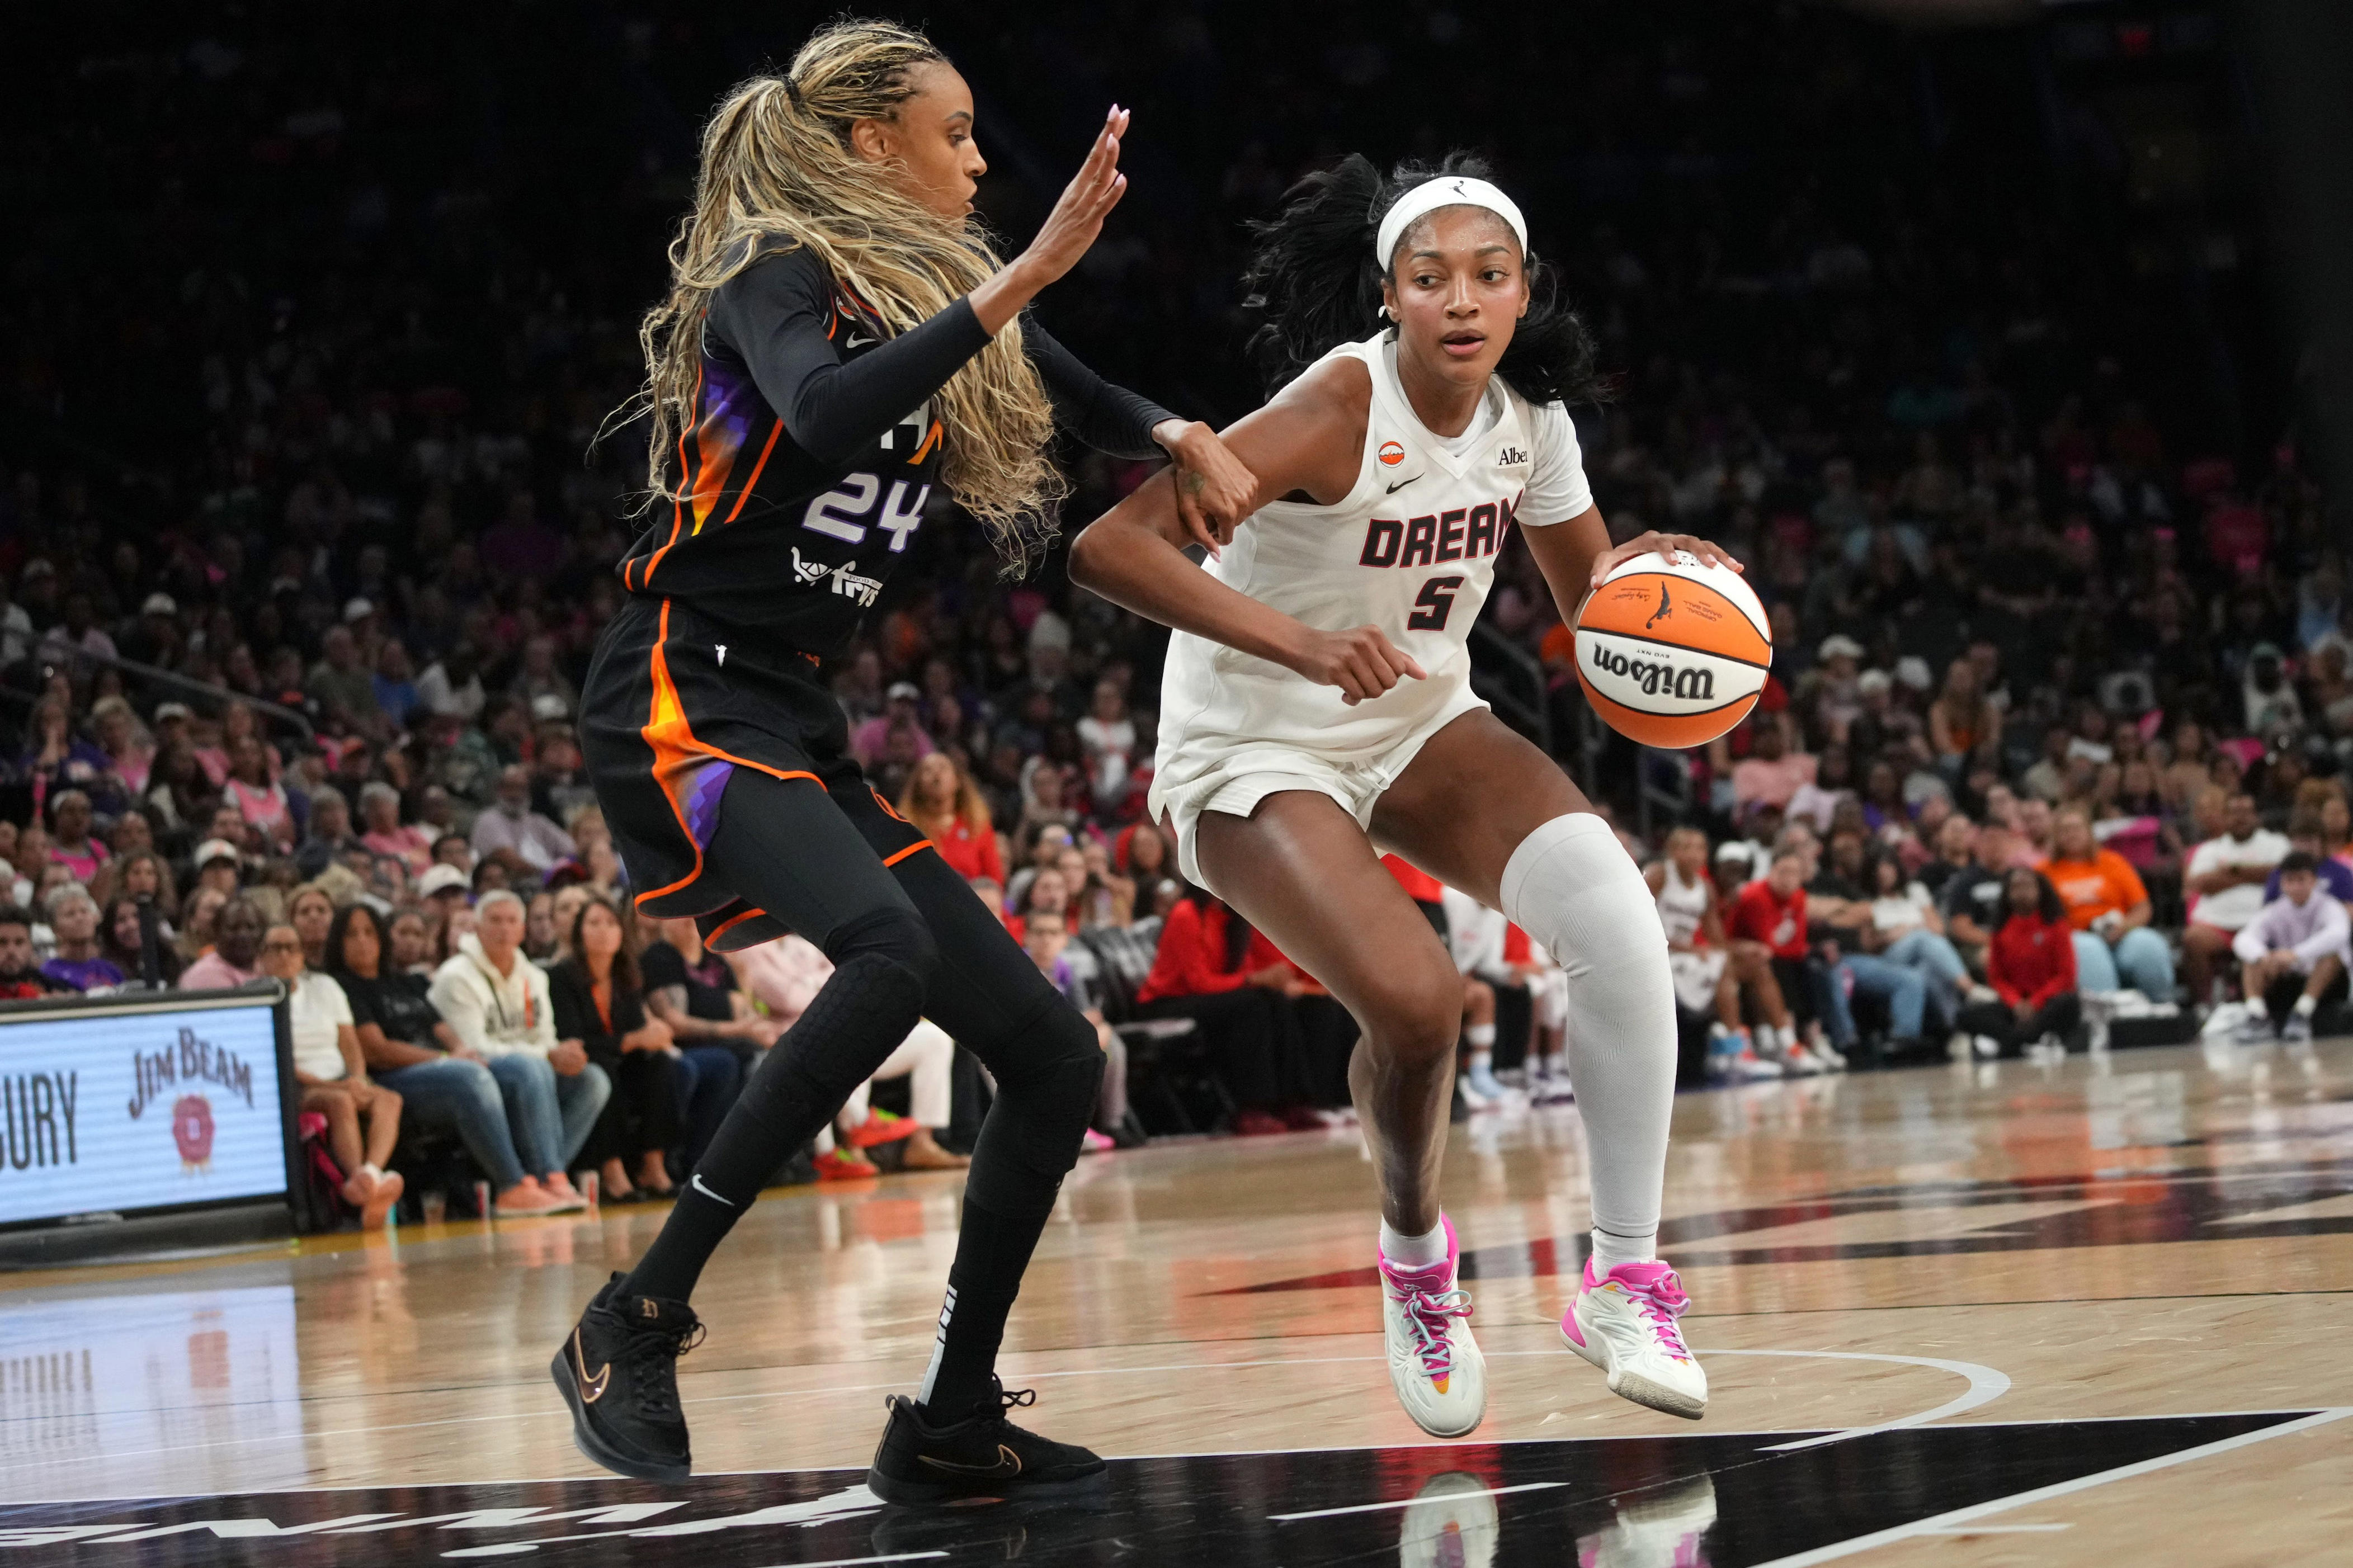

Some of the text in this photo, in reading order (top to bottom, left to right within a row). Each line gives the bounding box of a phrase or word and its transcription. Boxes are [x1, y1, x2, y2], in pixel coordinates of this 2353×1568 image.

[801, 471, 931, 553] 24
[848, 575, 870, 584] FOOD
[1407, 576, 1464, 631] 5
[1686, 607, 1717, 622] OFFICIAL
[1593, 641, 1715, 700] Wilson
[128, 1026, 255, 1120] JIM BEAM
[0, 1069, 77, 1170] URY
